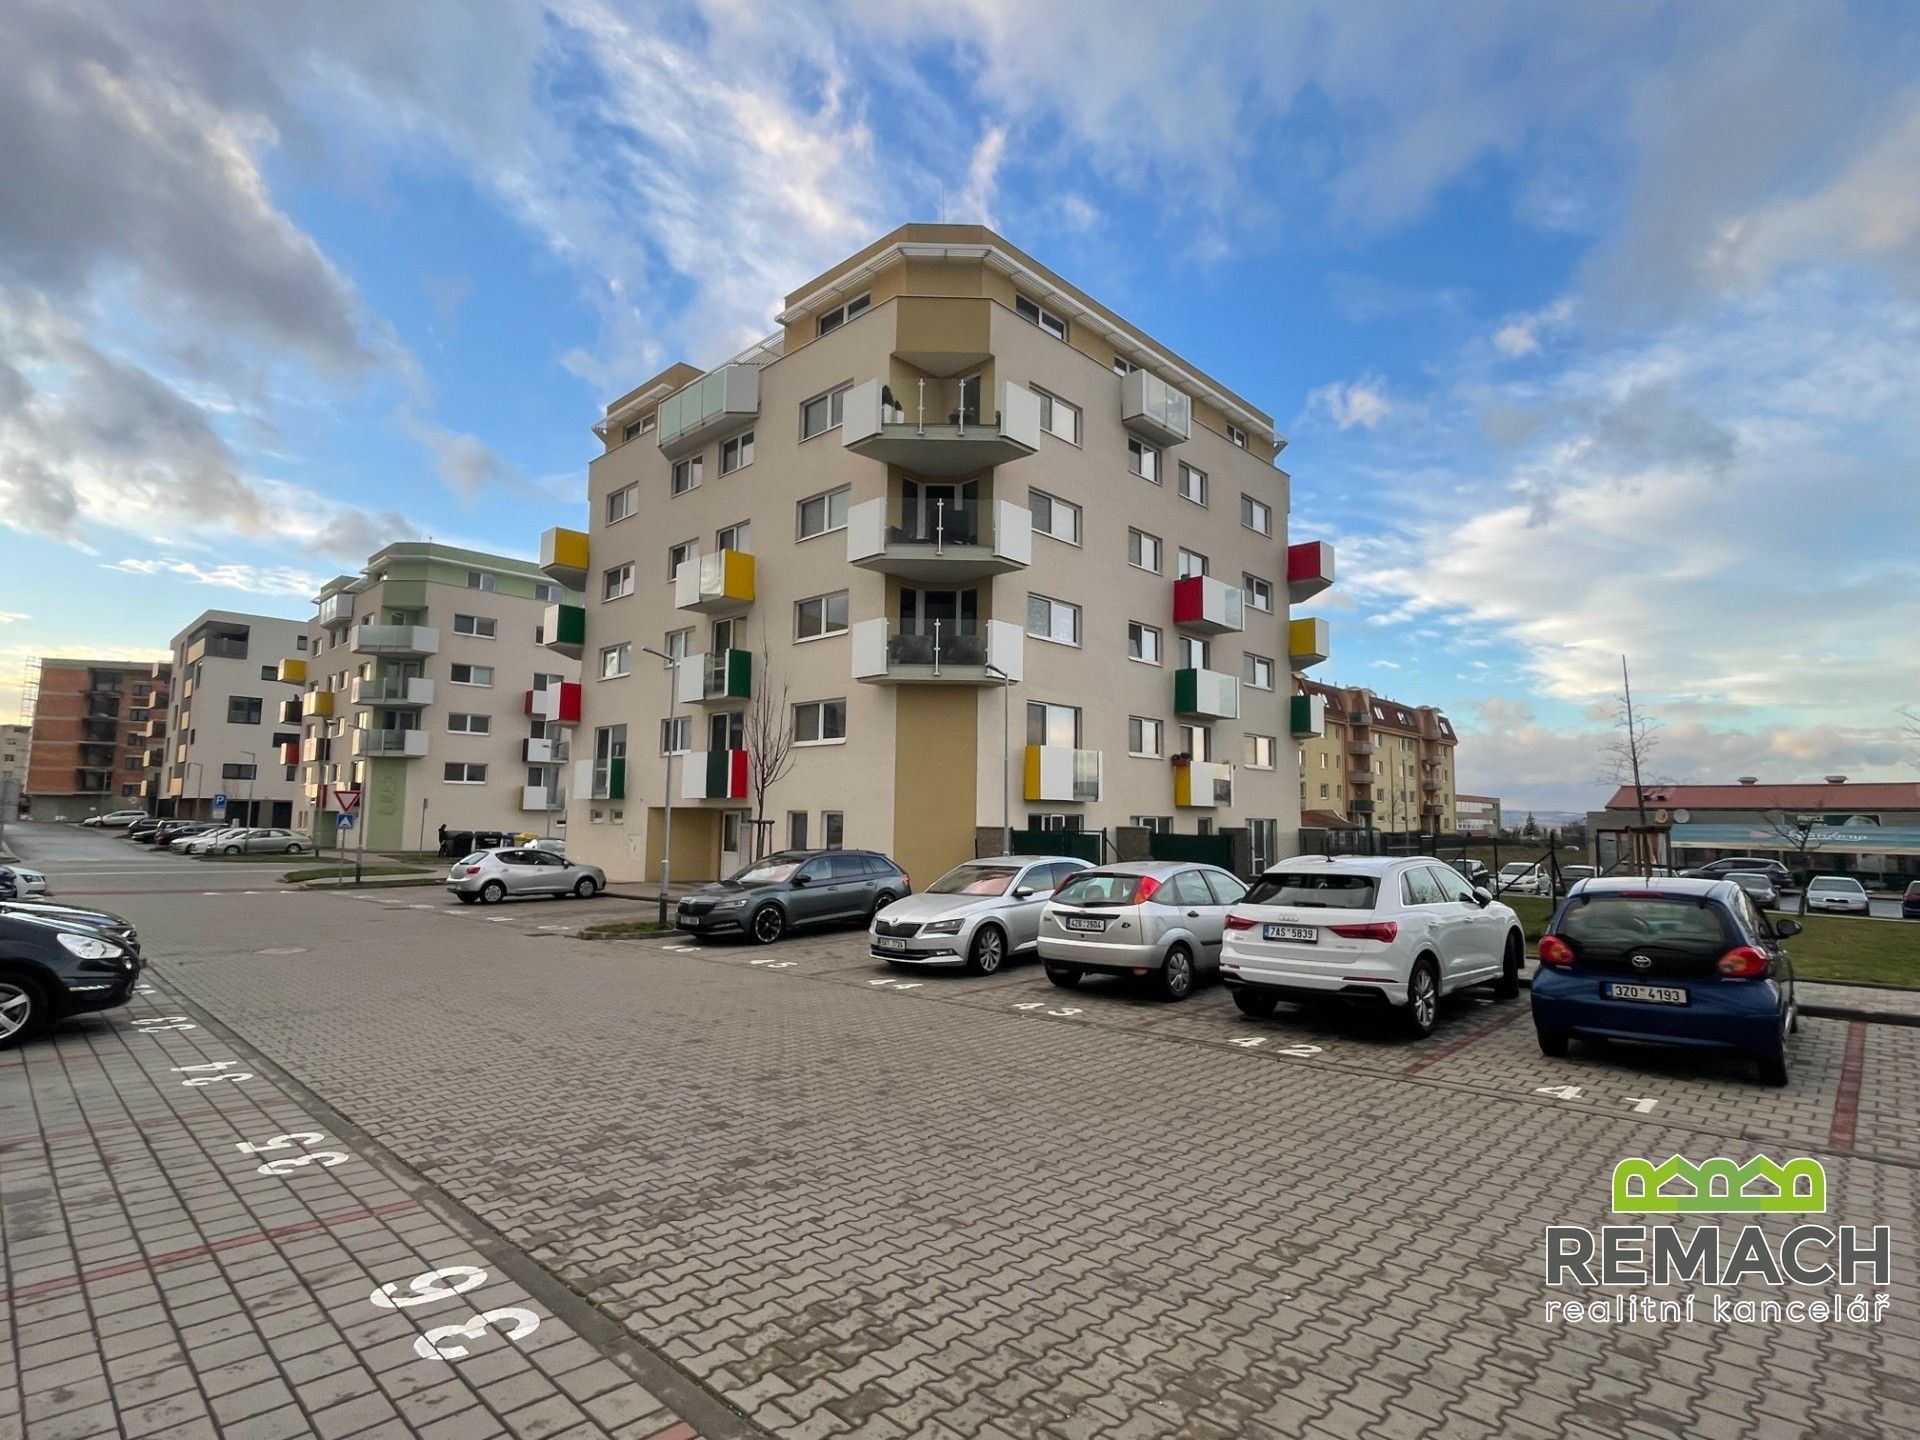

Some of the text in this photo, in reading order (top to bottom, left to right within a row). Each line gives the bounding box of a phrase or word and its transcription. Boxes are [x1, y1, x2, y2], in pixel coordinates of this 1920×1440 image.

[1270, 927, 1313, 939] 7AS 5839
[1615, 986, 1680, 1001] 3Z0 4193
[1228, 1036, 1323, 1057] 42
[1535, 1085, 1659, 1114] 41
[235, 1131, 350, 1177] 35
